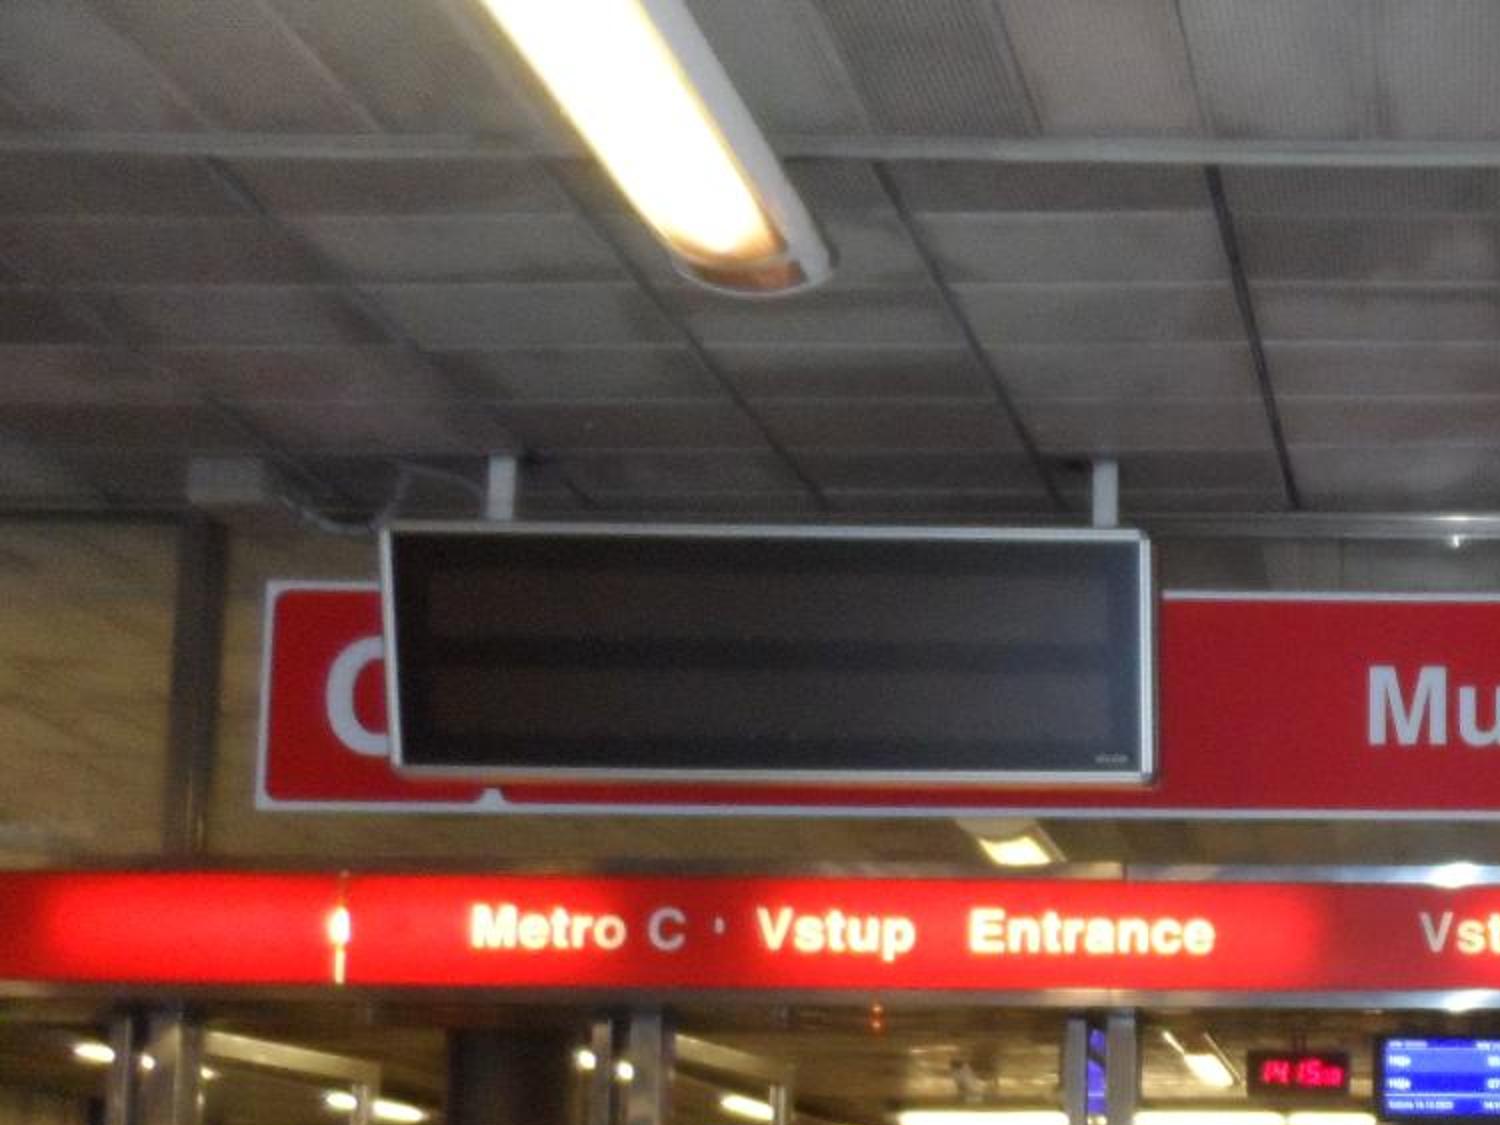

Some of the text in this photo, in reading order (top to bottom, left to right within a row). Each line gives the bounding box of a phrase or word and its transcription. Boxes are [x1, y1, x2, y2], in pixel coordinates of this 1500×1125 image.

[470, 904, 1215, 962] Metro C Vstup Entrance
